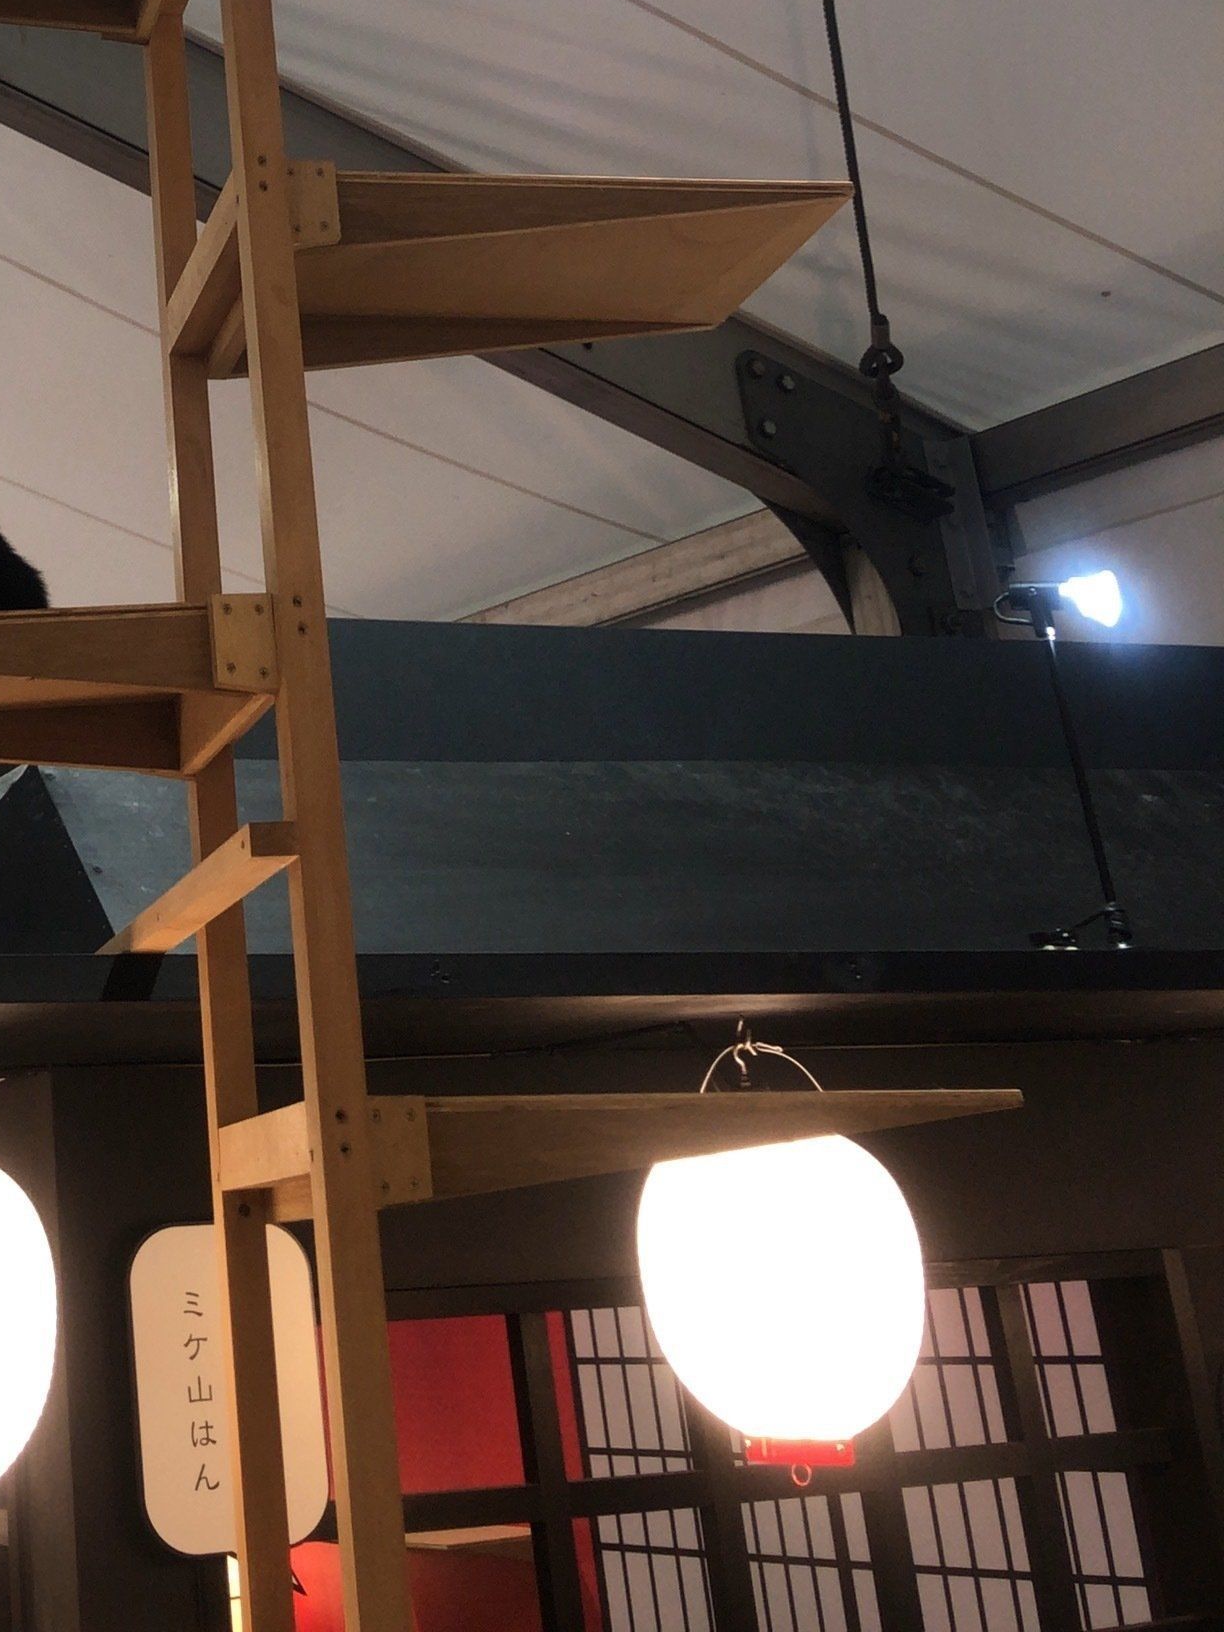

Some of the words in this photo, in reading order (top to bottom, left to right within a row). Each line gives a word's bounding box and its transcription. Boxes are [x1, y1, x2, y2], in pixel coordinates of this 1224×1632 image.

[183, 1291, 220, 1491] ミケ山はん
